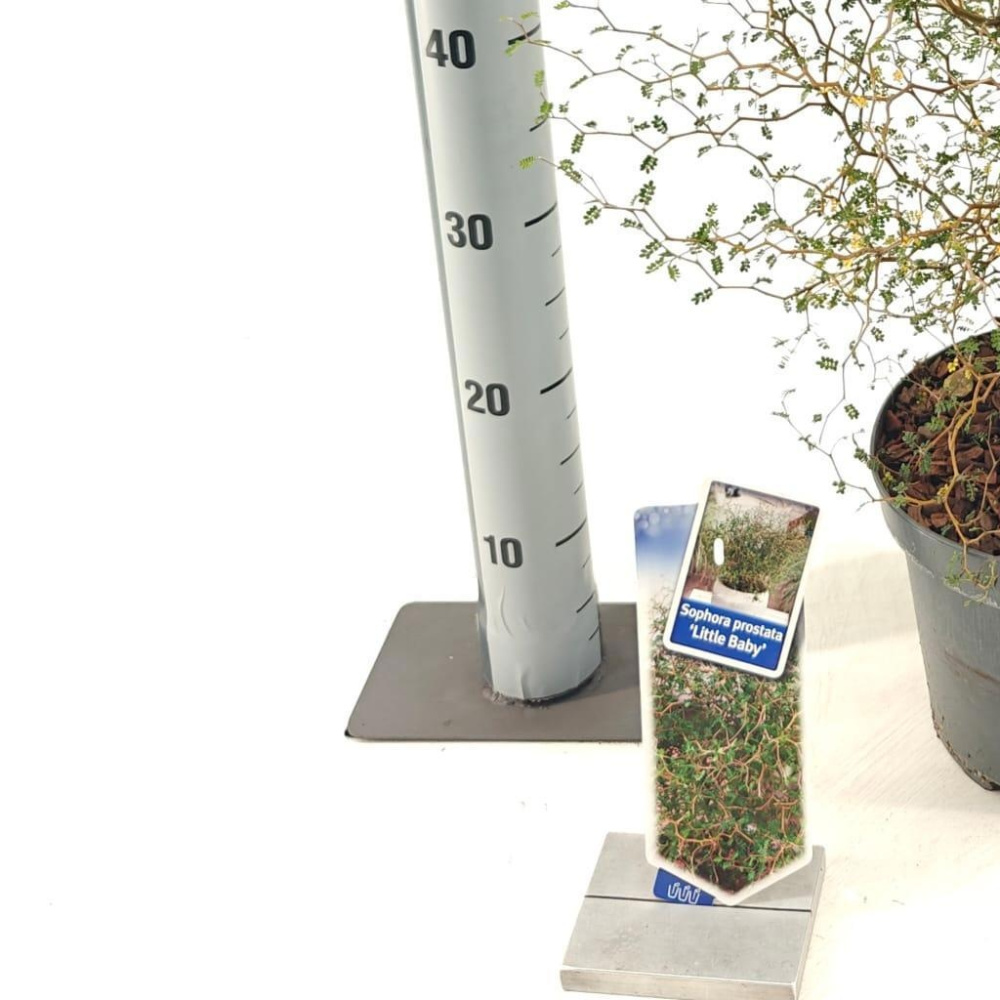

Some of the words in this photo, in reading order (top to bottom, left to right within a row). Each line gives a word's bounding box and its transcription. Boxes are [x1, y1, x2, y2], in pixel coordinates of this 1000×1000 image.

[425, 28, 476, 70] 40
[445, 211, 493, 250] 30
[465, 379, 510, 416] 20
[483, 535, 523, 568] 10
[680, 603, 731, 628] Sophora
[731, 619, 783, 642] prostata
